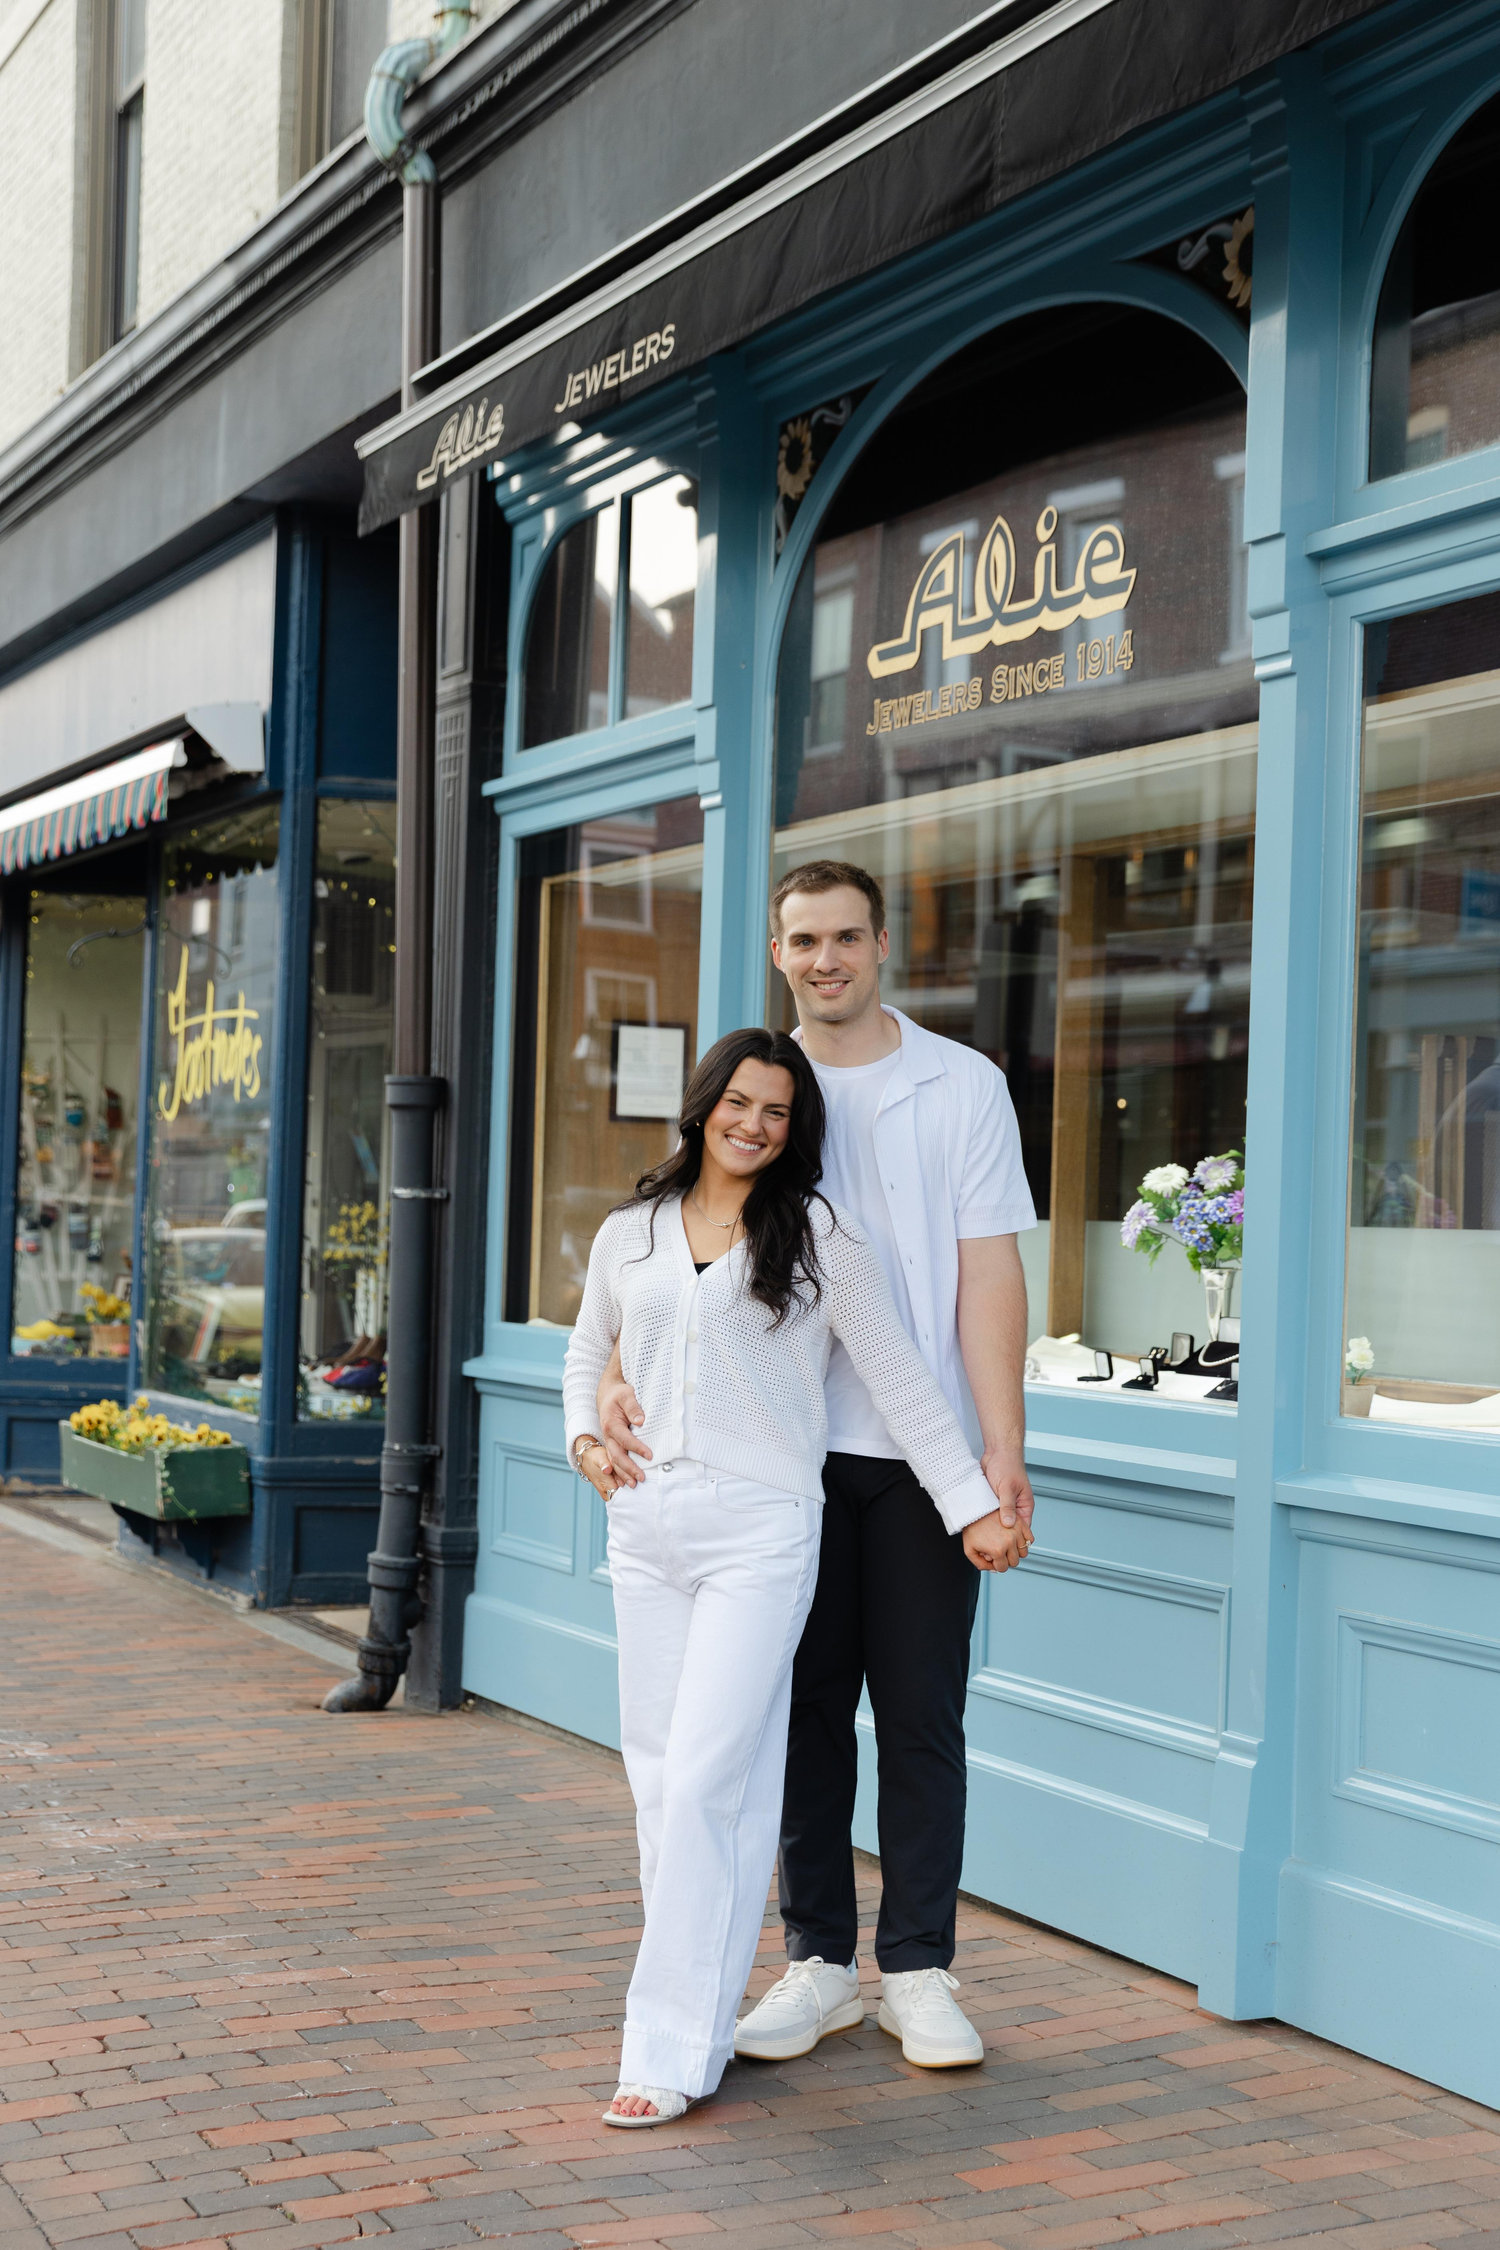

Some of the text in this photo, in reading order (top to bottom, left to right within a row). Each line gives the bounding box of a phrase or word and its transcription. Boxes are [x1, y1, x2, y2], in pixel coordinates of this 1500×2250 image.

[416, 323, 676, 491] Alie JEWELERS
[867, 505, 1137, 679] Alie
[866, 630, 1134, 736] JEWELERS SINCE 1914
